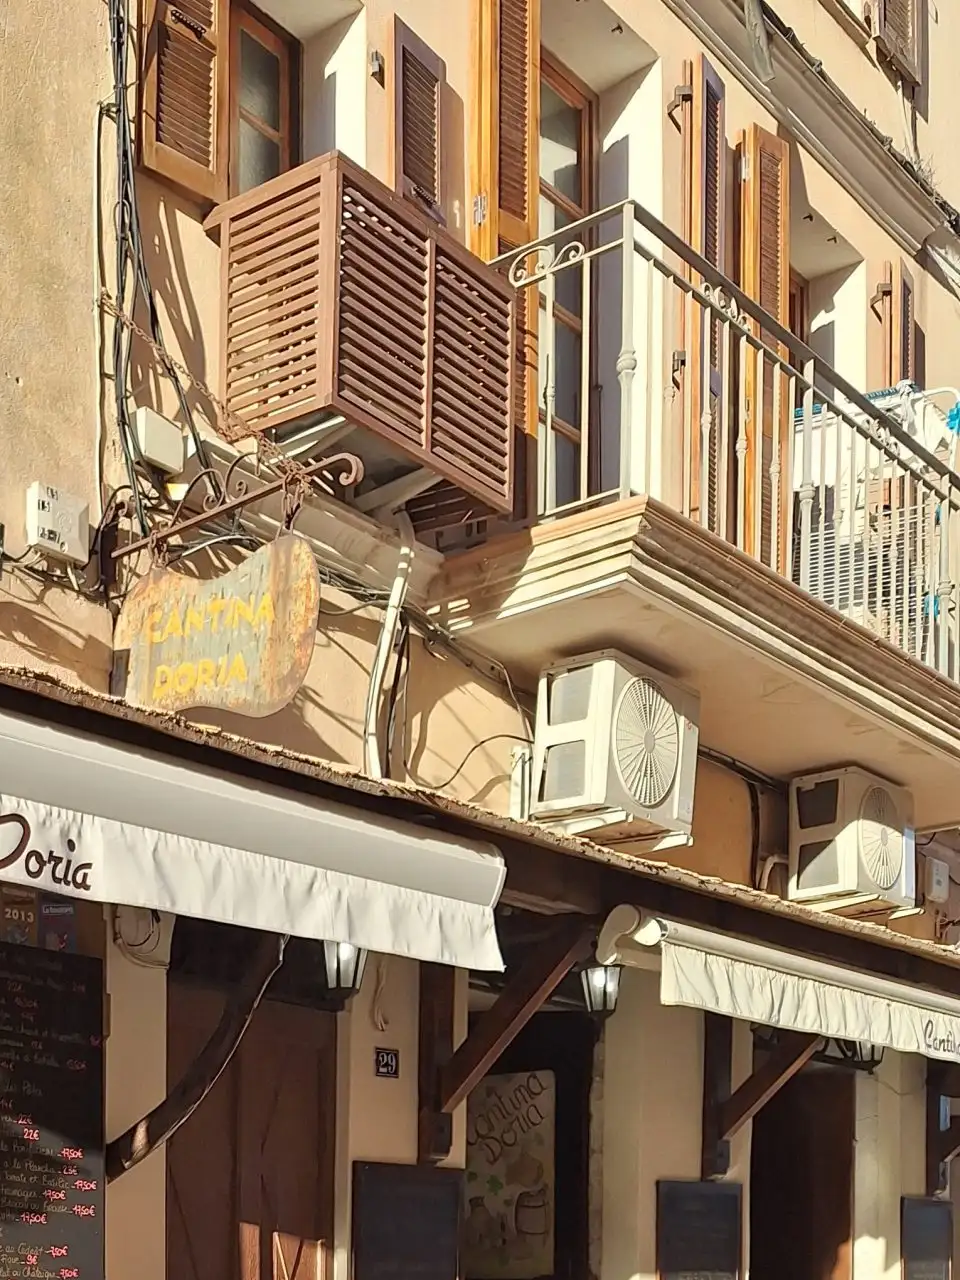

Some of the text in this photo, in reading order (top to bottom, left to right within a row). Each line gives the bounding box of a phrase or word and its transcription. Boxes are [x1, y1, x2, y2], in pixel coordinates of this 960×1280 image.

[149, 592, 276, 644] CANTINA
[152, 651, 248, 700] DORIA
[4, 907, 35, 923] 2013
[378, 1052, 396, 1074] 29
[23, 1127, 40, 1142] 22€
[19, 1211, 49, 1226] 17,50€
[26, 1253, 38, 1266] 9€
